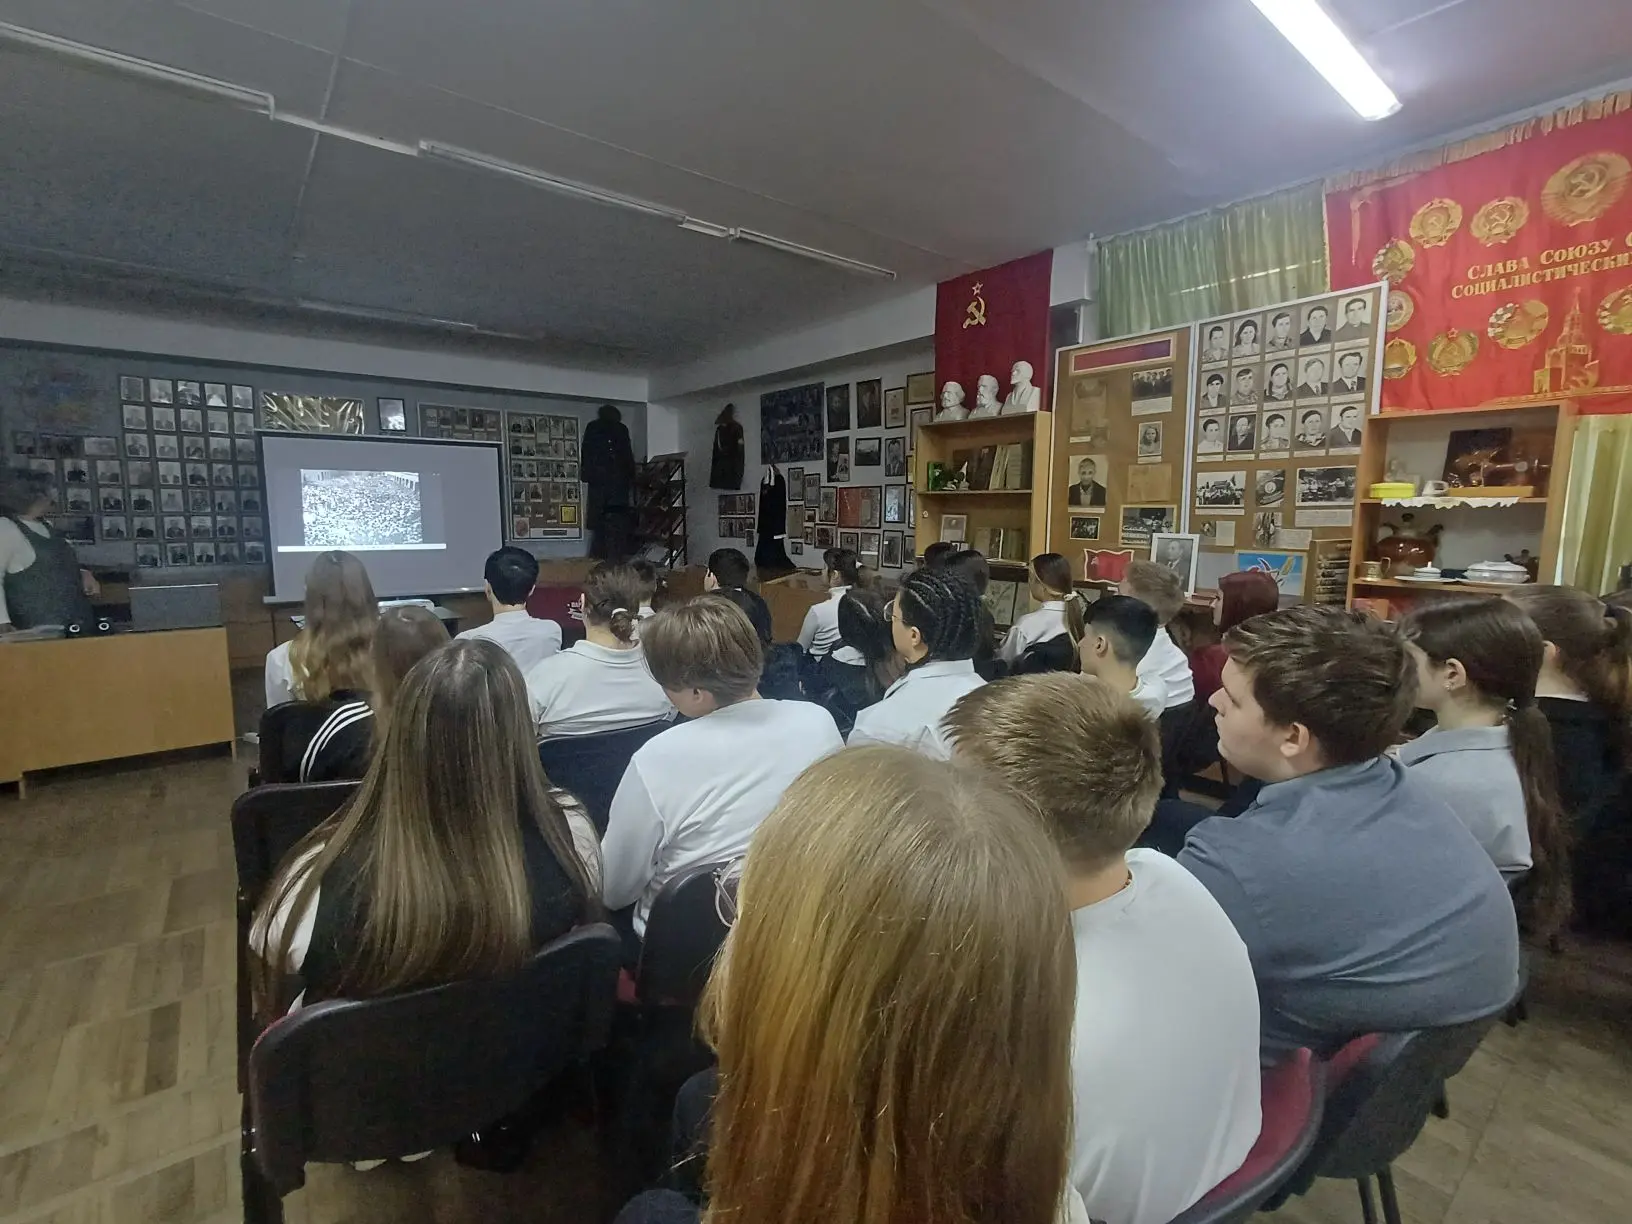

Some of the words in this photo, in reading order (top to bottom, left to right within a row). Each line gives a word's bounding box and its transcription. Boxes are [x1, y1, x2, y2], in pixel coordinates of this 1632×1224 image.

[1451, 251, 1632, 299] СОЦИАЛИСТИЧЕСКИ
[1467, 256, 1530, 280] СЛАВА
[1539, 238, 1615, 266] СОЮЗУ
